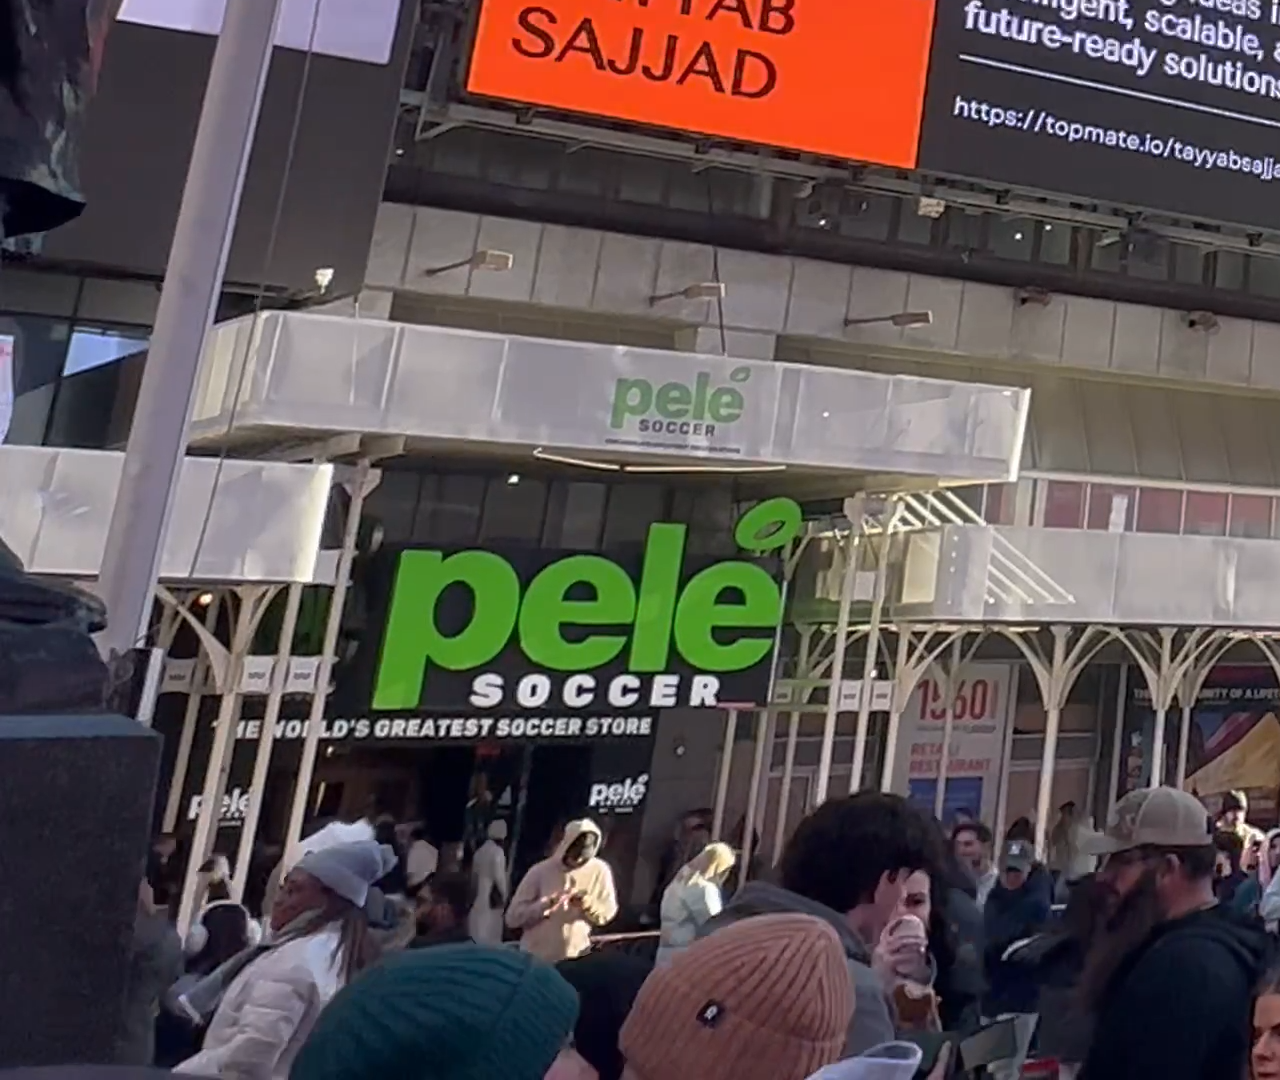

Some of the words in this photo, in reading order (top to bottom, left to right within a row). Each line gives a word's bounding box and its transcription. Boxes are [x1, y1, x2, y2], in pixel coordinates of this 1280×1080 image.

[510, 5, 777, 100] SAJJAD
[964, 0, 1157, 78] future-ready
[1143, 8, 1265, 62] scalable,
[610, 366, 752, 430] pelé
[638, 418, 716, 437] SOCCER
[372, 497, 803, 711] pelé
[469, 672, 721, 709] SOCCER
[373, 718, 497, 738] GREATEST
[496, 717, 582, 737] SOCCER
[584, 717, 653, 736] STORE
